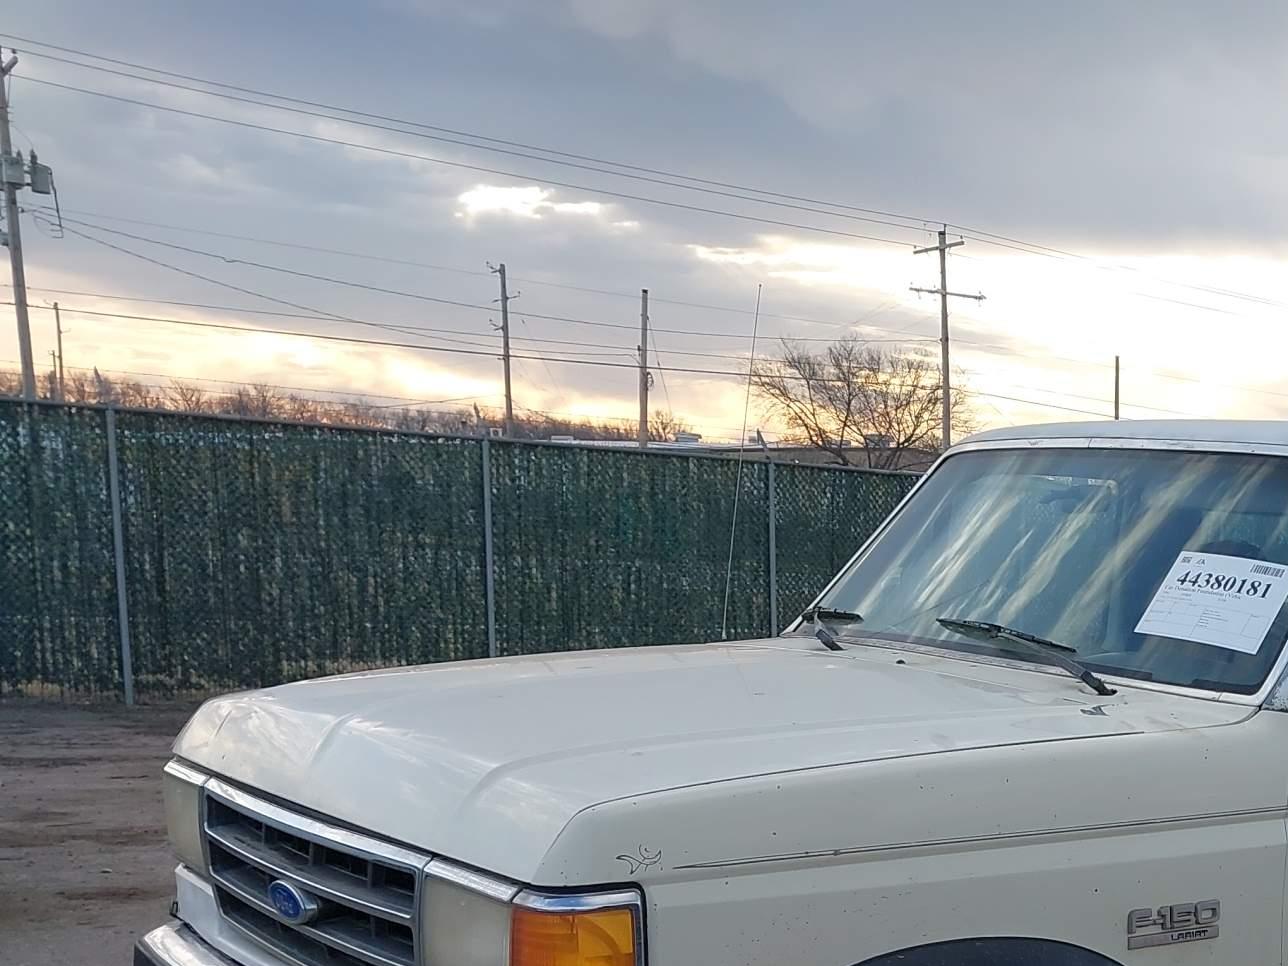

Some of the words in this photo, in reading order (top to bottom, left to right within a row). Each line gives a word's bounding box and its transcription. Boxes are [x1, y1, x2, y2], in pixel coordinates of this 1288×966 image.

[1176, 569, 1272, 600] 44380181
[1127, 899, 1221, 935] F-150
[1170, 929, 1209, 942] LARIAT
